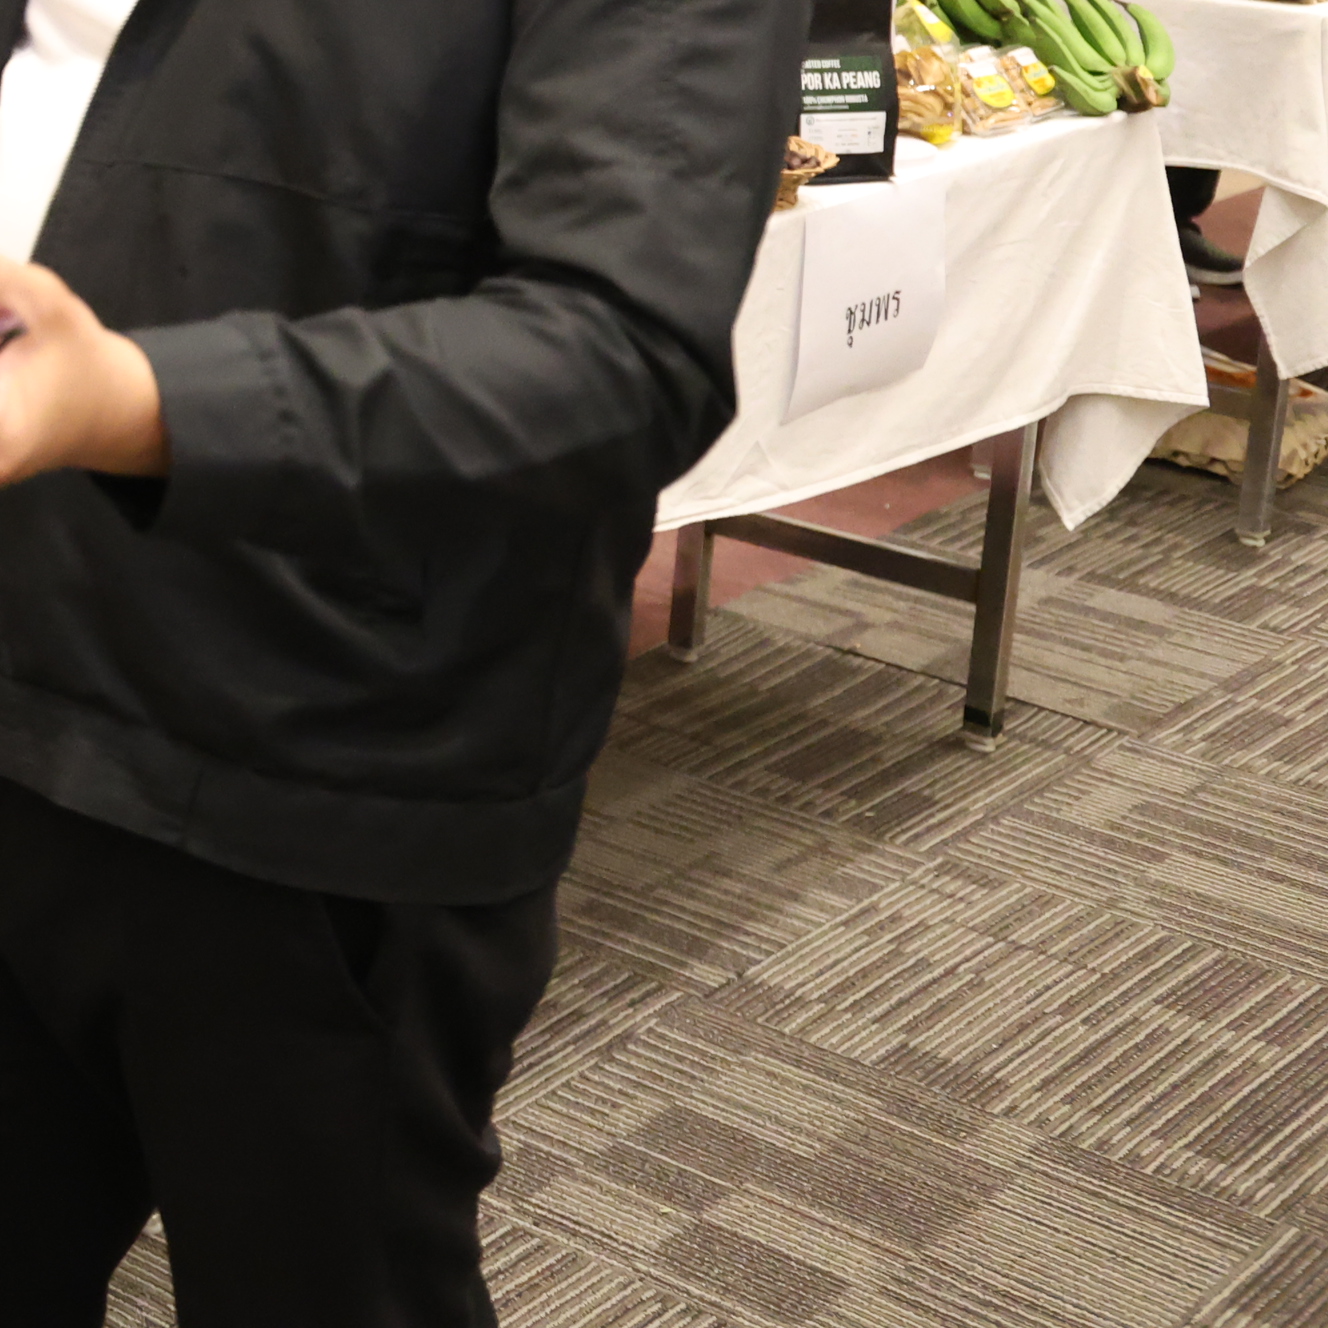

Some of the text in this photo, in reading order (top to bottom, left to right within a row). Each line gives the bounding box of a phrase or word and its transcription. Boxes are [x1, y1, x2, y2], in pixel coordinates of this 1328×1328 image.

[801, 70, 881, 90] POR KA PEANG
[846, 290, 901, 348] ชุมพร
